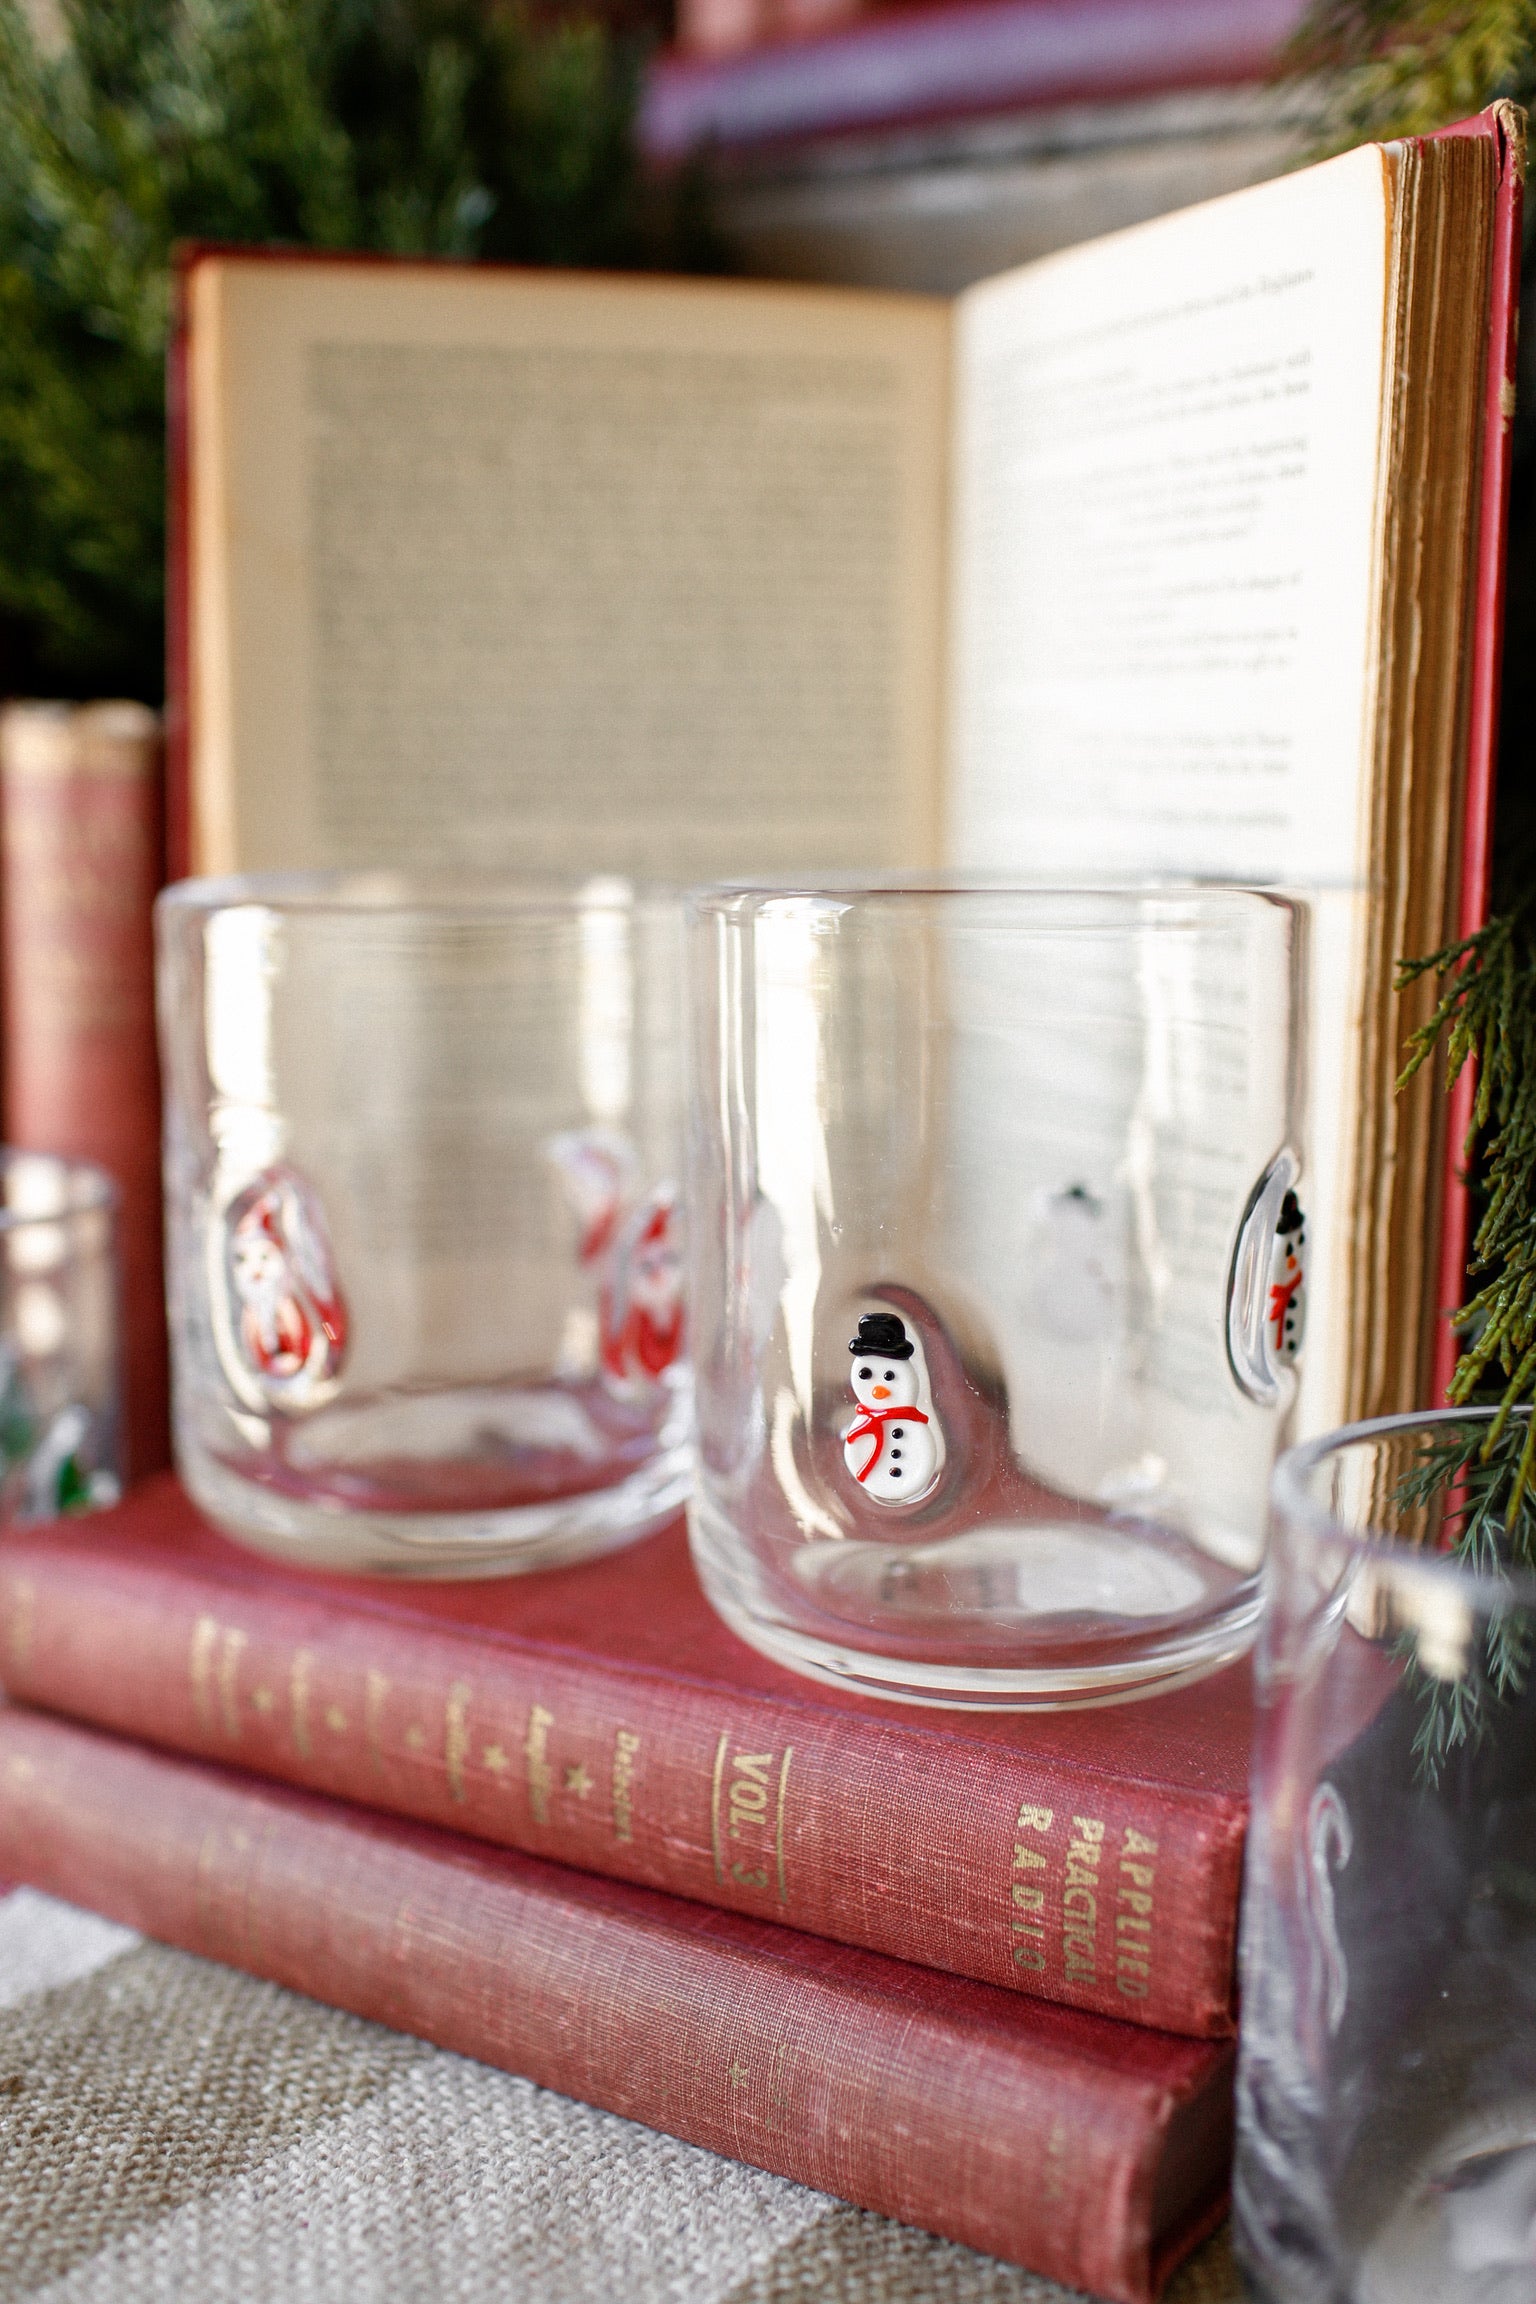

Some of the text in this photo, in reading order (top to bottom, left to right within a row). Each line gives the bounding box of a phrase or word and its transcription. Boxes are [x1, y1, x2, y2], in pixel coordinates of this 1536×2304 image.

[728, 1752, 773, 1890] VOL. 3
[1011, 1803, 1054, 1972] RADIO
[1062, 1815, 1106, 1985] PRACTICAL
[1116, 1826, 1159, 1999] APPLIED
